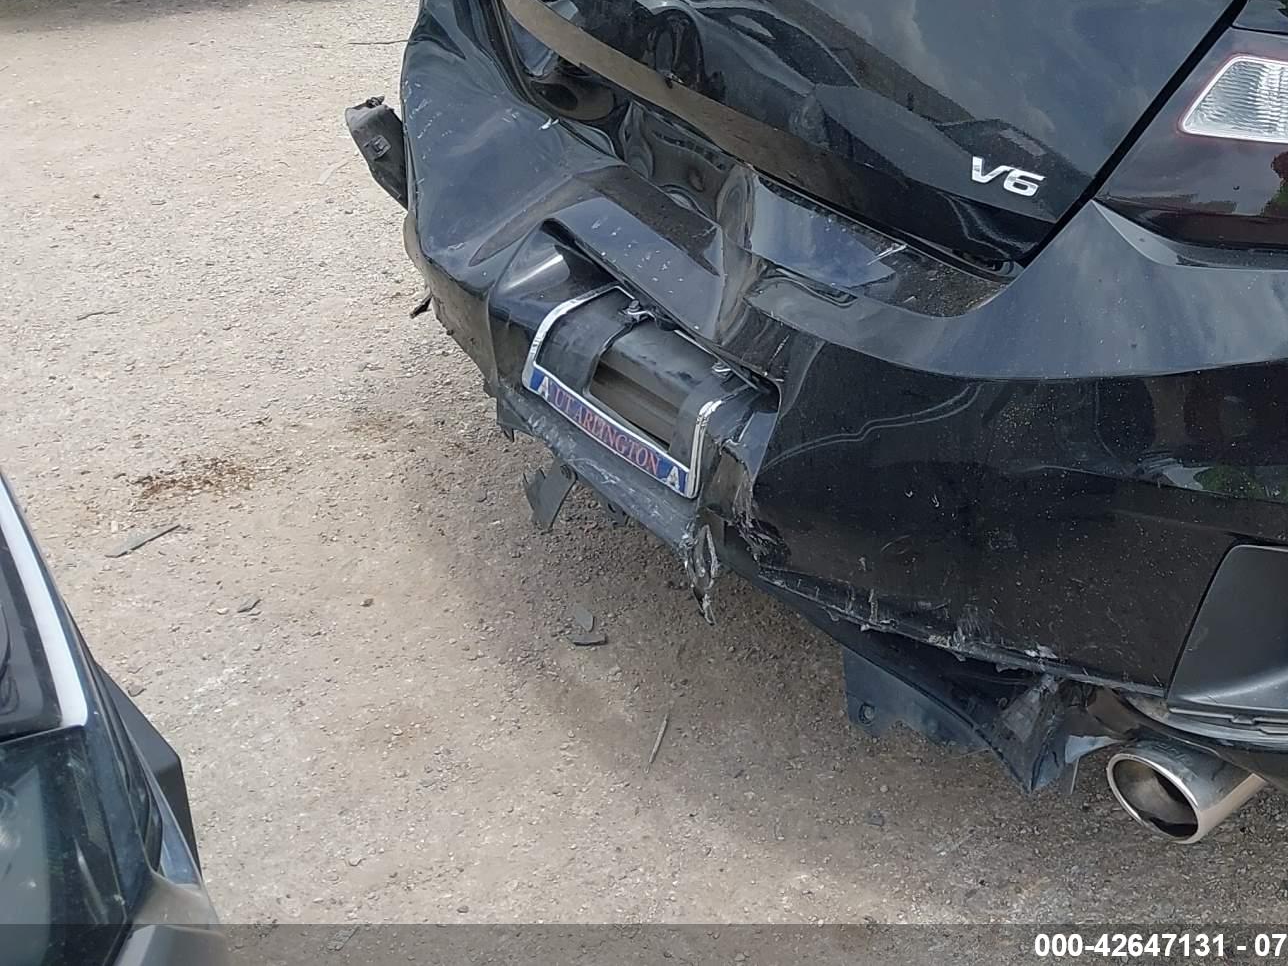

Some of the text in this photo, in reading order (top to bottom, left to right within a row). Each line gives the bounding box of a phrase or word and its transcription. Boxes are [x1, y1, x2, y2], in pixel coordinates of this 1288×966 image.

[971, 156, 1047, 197] V6
[553, 386, 577, 414] UT
[575, 405, 661, 475] ARLINGTON
